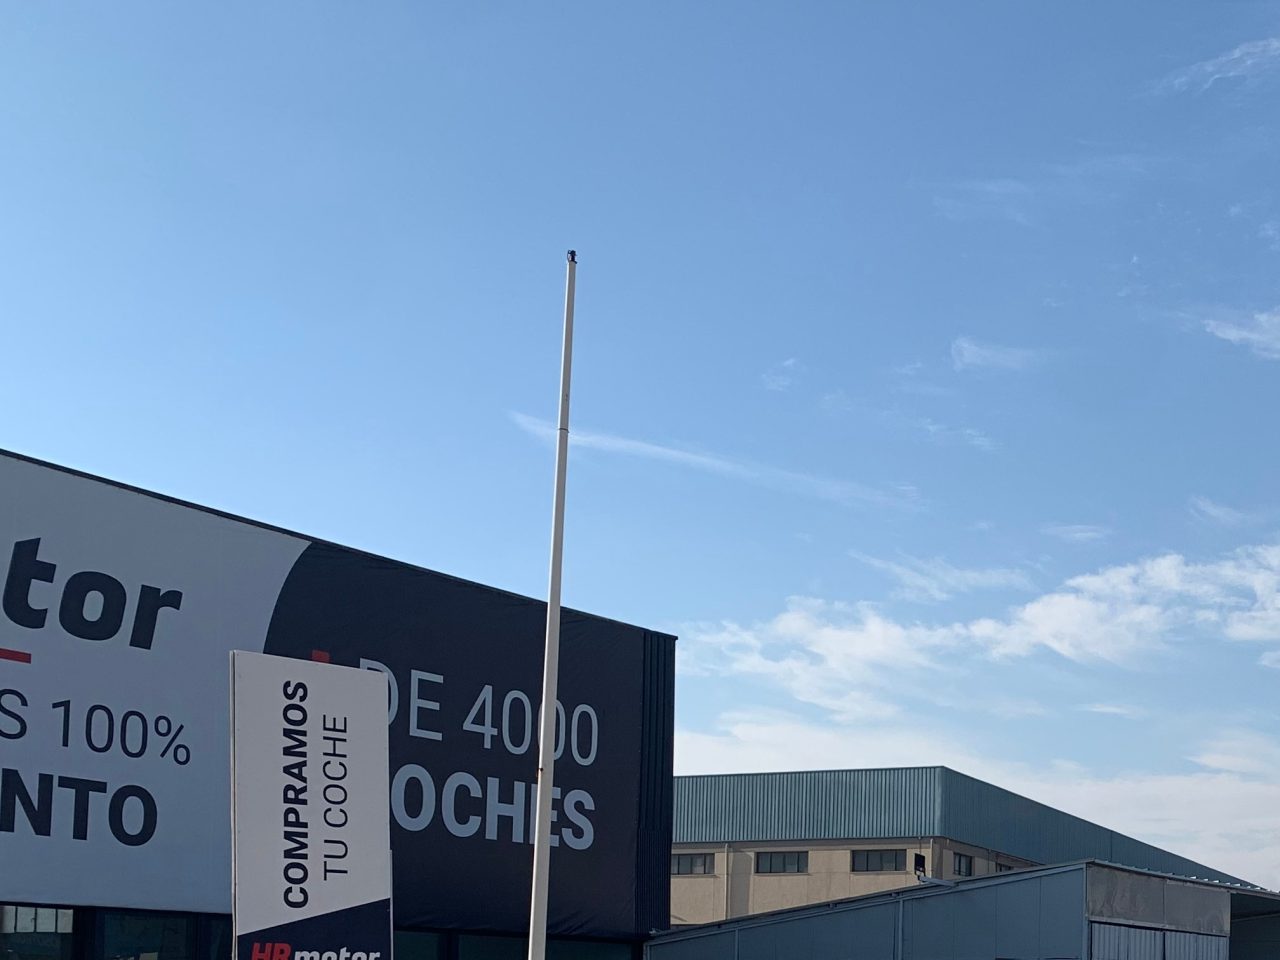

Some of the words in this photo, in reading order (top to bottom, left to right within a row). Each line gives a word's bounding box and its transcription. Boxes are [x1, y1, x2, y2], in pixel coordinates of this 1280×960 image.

[51, 699, 191, 766] 100%
[462, 684, 598, 766] 4000
[282, 680, 308, 909] COMPRAMOS
[322, 715, 347, 827] COCHE
[391, 763, 596, 851] OCHES
[323, 839, 347, 881] TU
